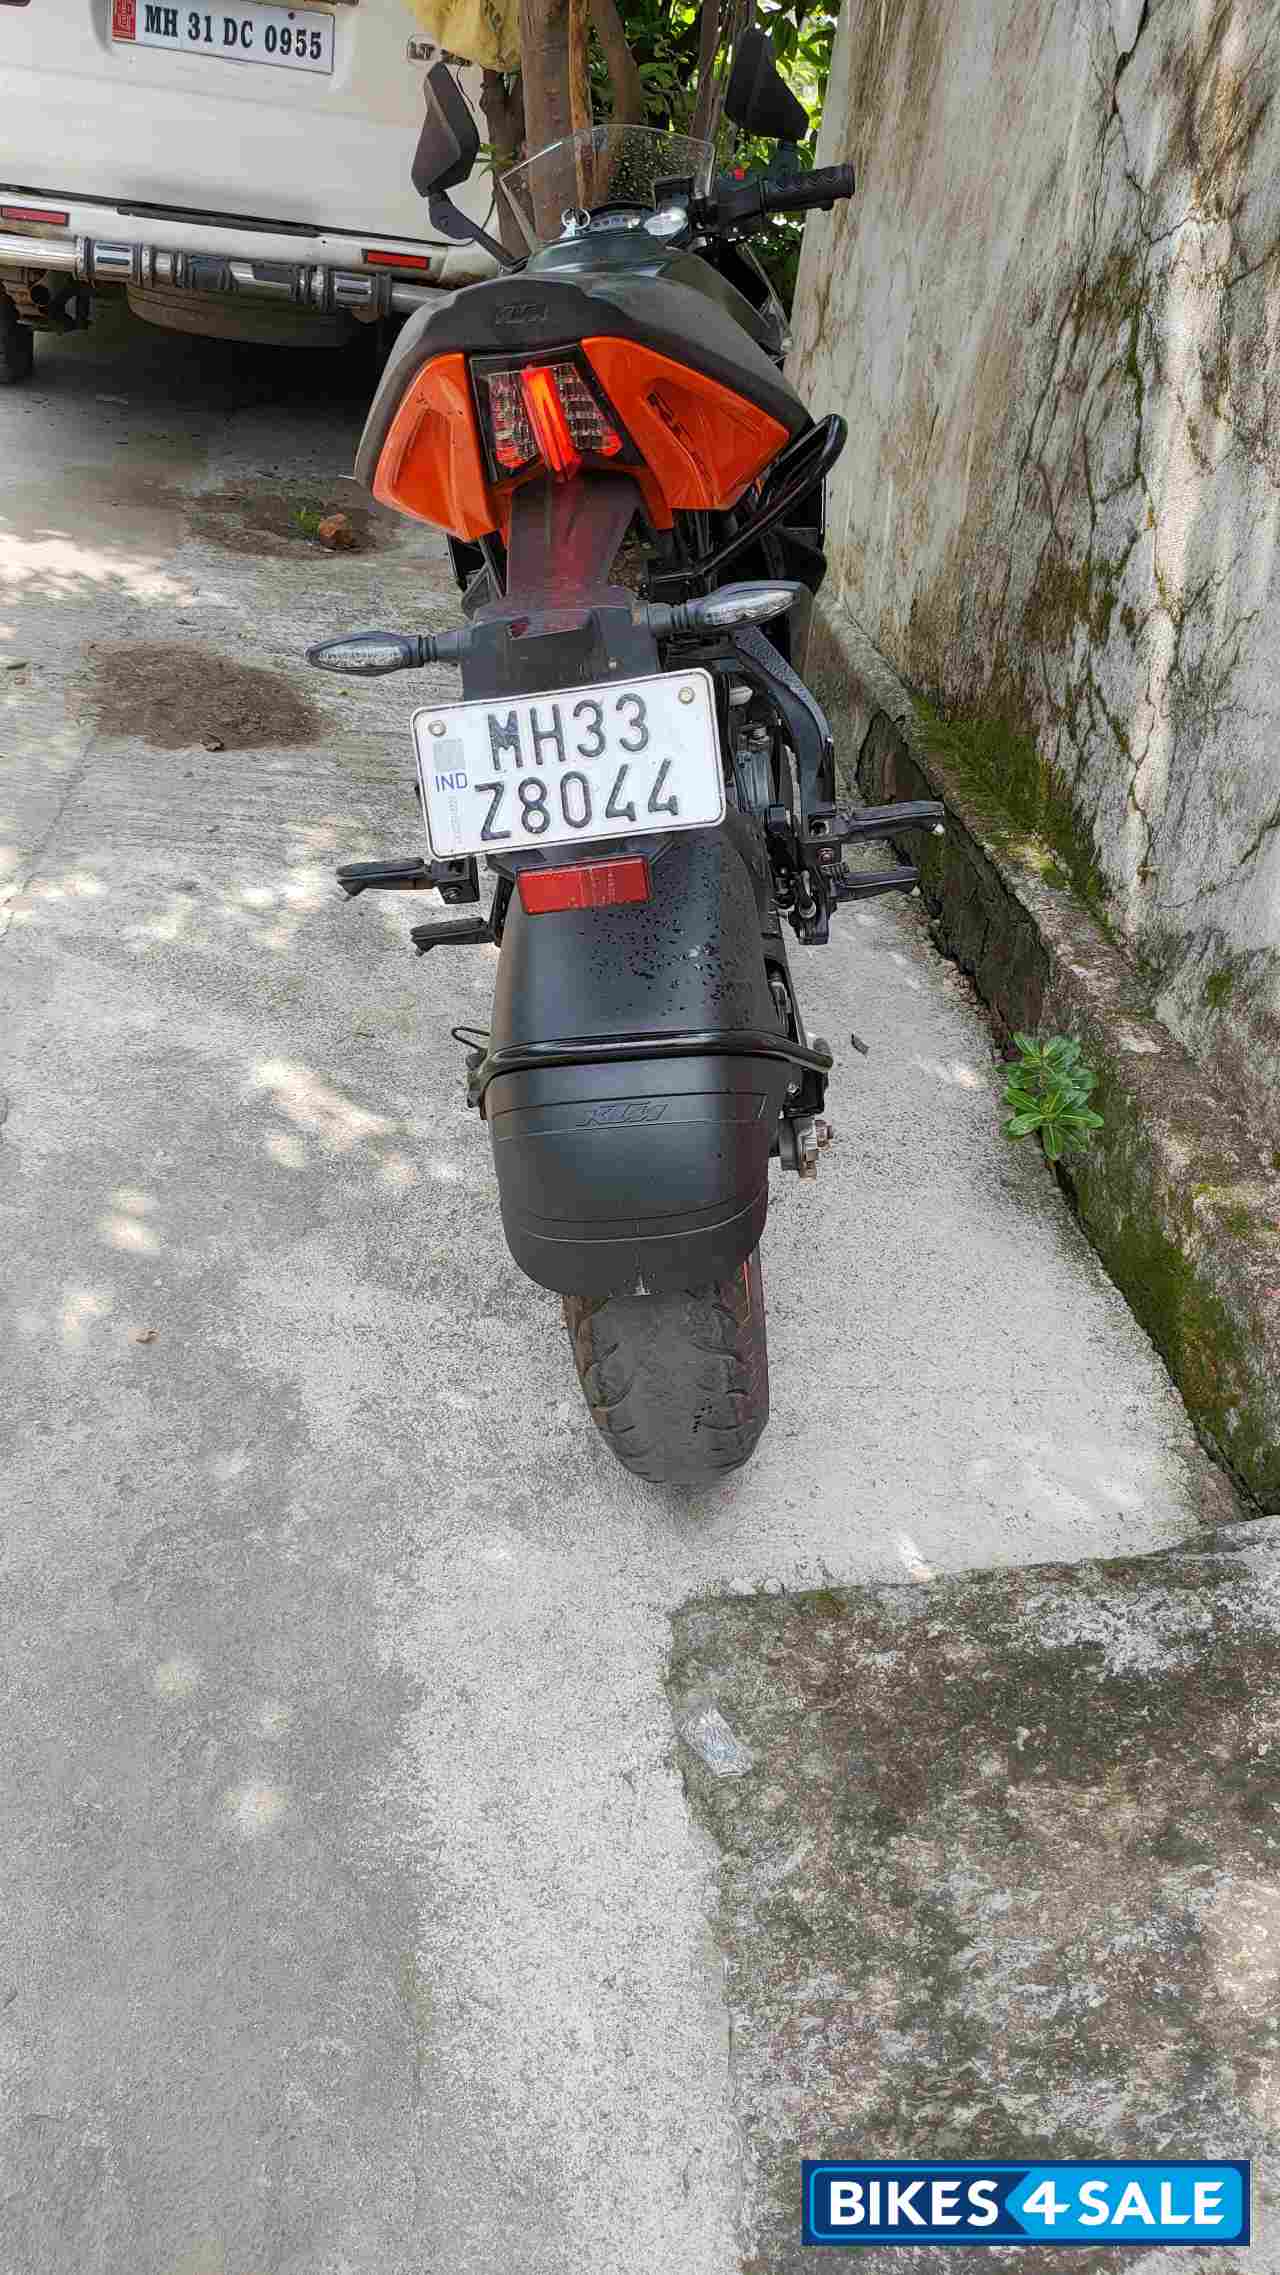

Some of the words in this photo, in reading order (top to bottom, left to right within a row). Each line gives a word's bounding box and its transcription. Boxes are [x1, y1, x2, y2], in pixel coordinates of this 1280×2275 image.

[145, 4, 178, 37] MH
[187, 14, 213, 43] 31
[223, 18, 253, 48] DC
[264, 25, 322, 60] 0955
[487, 693, 650, 771] MH33
[435, 772, 468, 793] IND
[475, 758, 680, 841] Z8044
